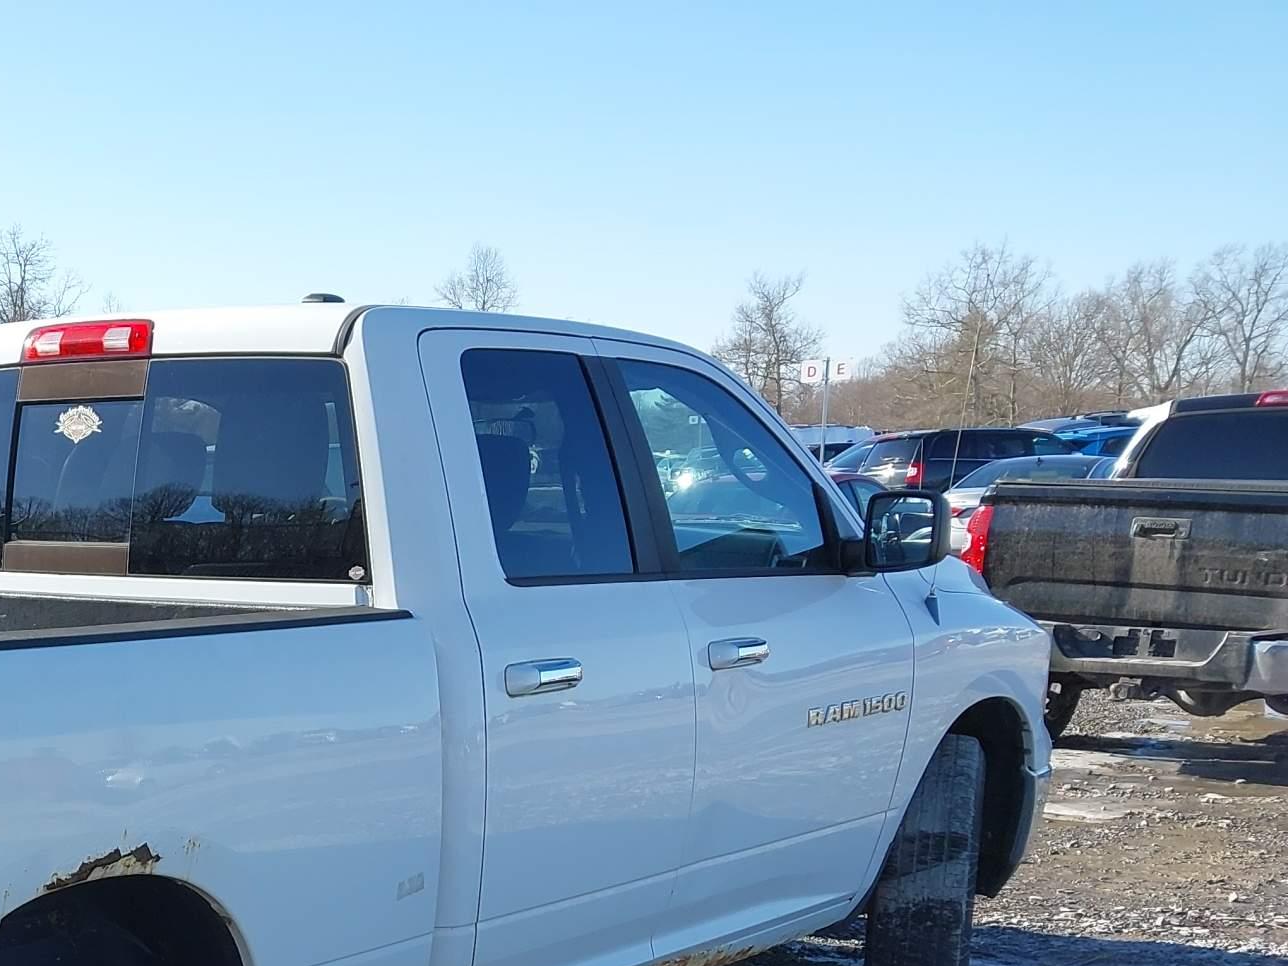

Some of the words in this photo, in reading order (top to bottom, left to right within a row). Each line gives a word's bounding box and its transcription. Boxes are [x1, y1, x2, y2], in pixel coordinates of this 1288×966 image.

[807, 366, 817, 377] D
[837, 362, 846, 375] E
[808, 700, 859, 728] RAM
[863, 691, 907, 716] 1500
